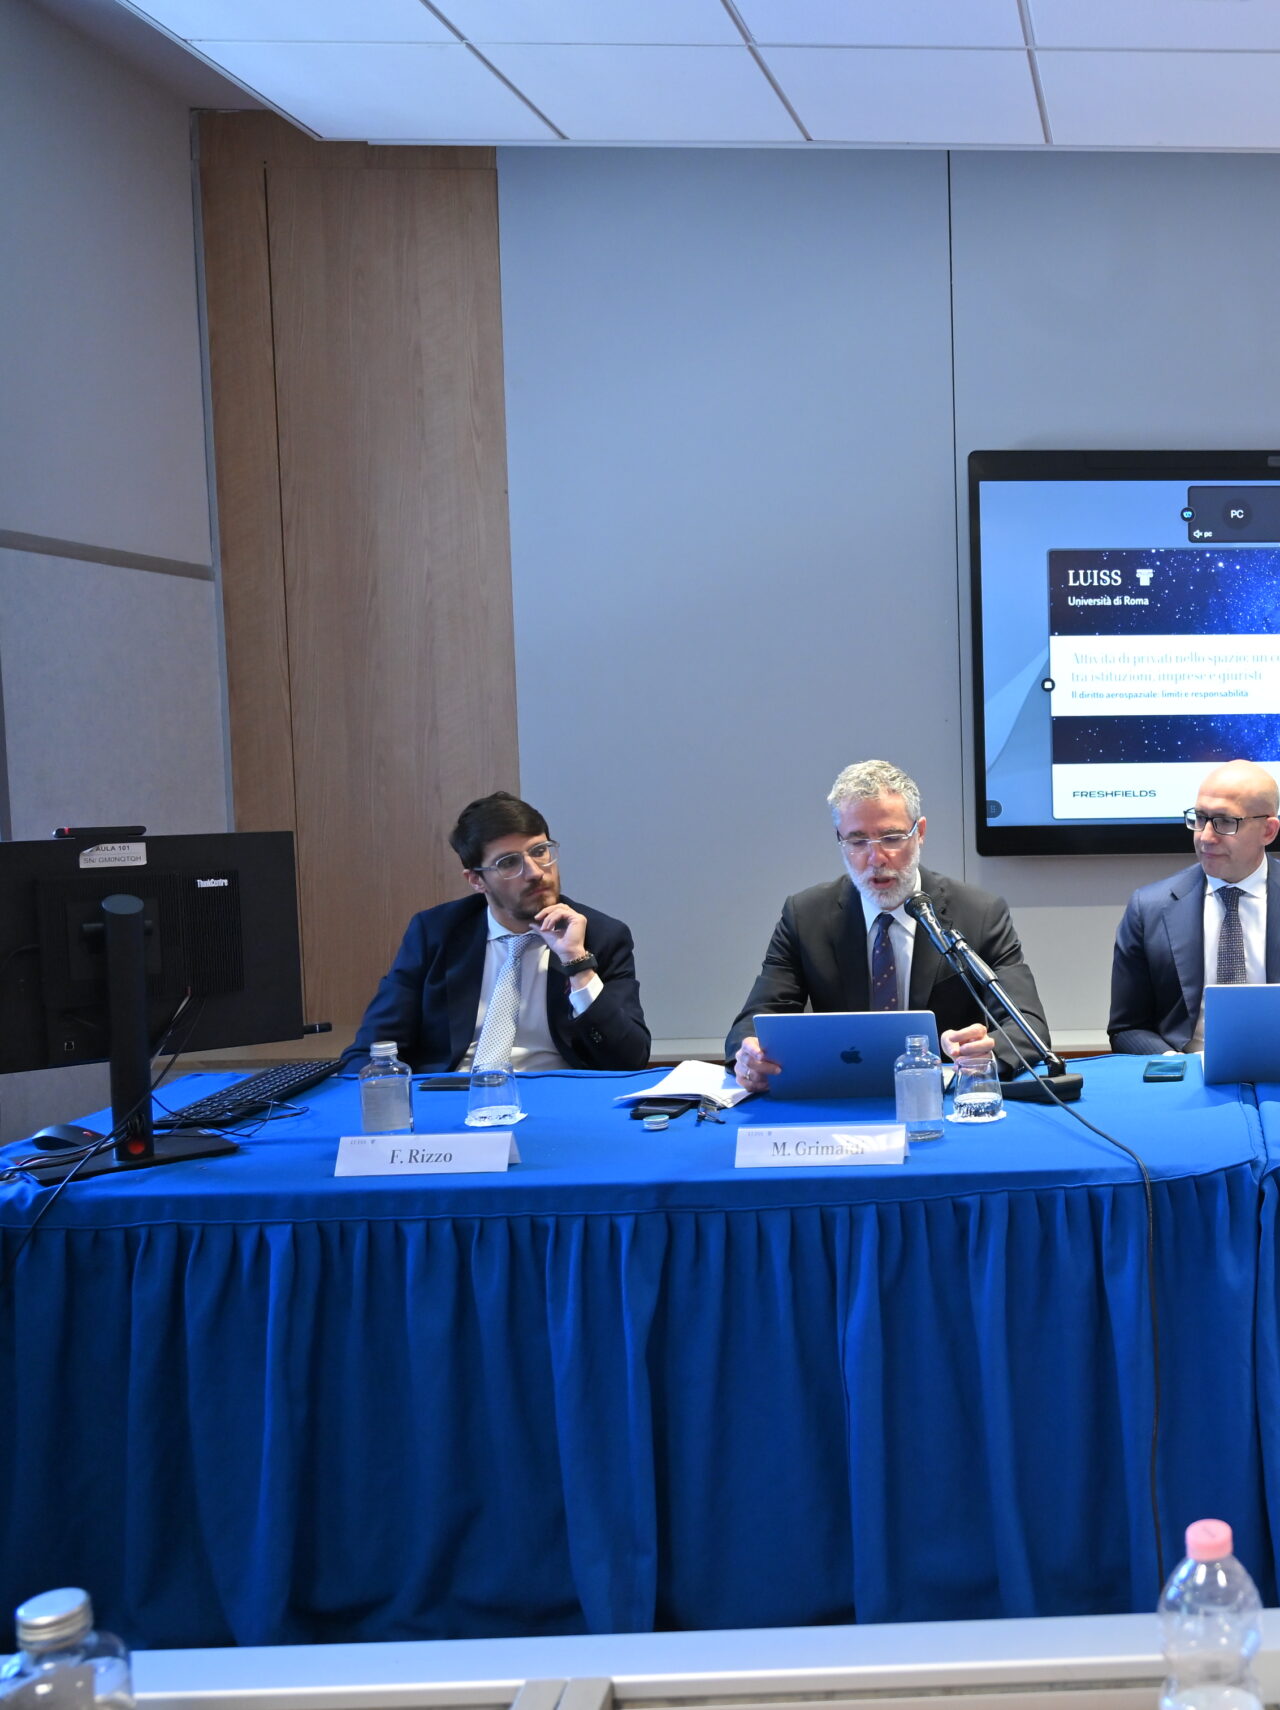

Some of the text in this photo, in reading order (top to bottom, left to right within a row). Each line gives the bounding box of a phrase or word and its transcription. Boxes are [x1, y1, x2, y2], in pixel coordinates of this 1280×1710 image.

[1230, 510, 1244, 519] PC
[1203, 530, 1213, 538] pc
[1067, 569, 1123, 586] LUISS
[1067, 595, 1150, 606] Università di Roma
[1078, 690, 1104, 699] diritto
[1072, 789, 1157, 799] FRESHFIELDS
[771, 1141, 791, 1157] M.
[390, 1148, 453, 1164] F. Rizzo
